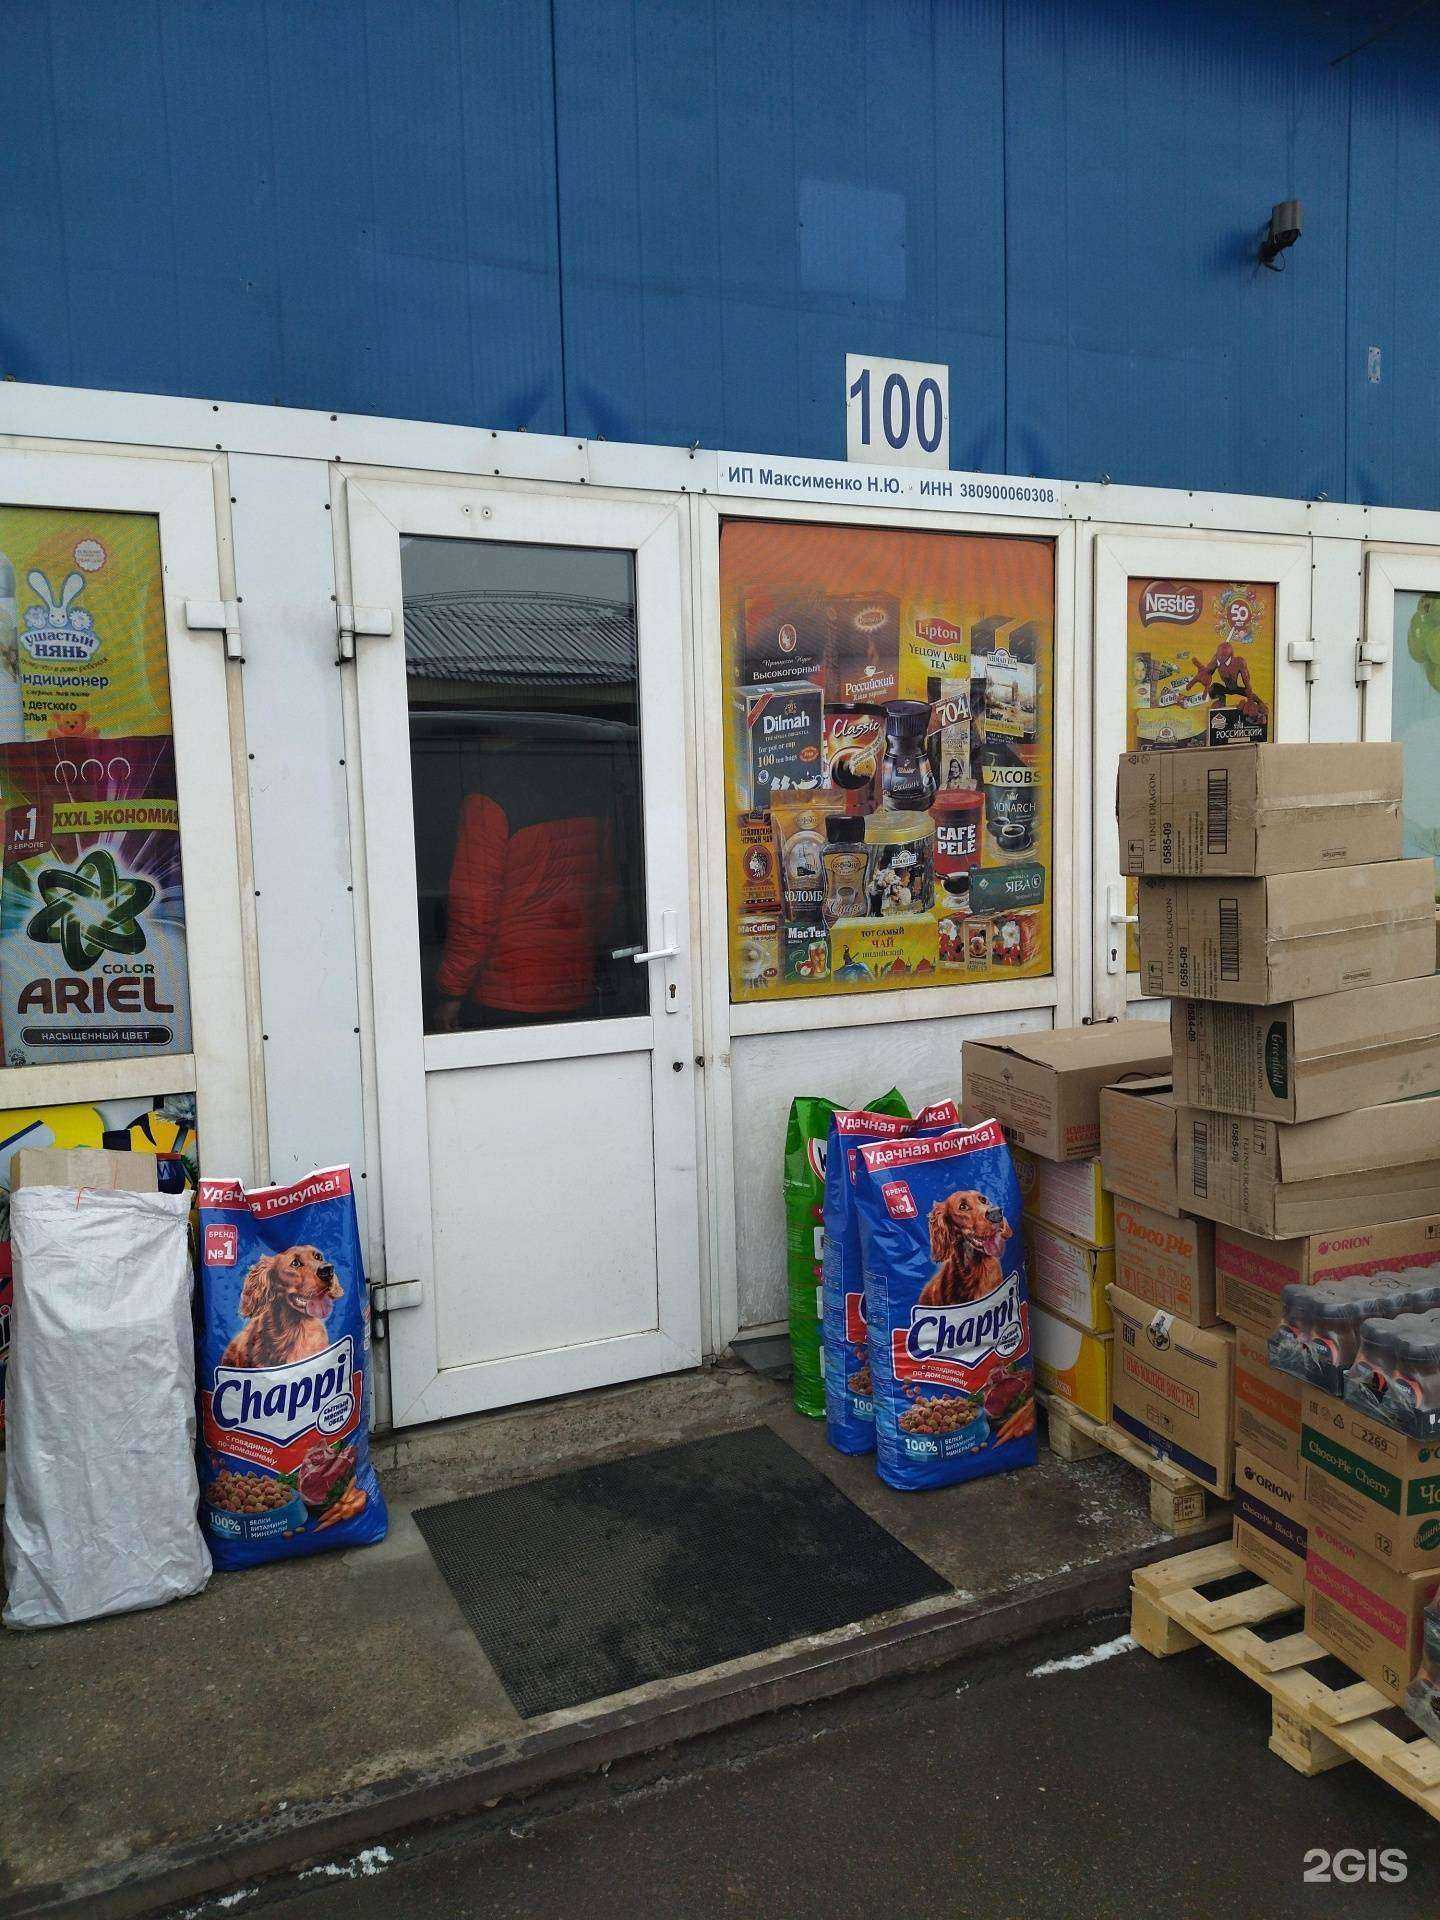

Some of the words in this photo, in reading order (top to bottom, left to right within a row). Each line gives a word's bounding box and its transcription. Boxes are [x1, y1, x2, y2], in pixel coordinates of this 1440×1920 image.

[850, 369, 942, 452] 100
[728, 466, 753, 484] ИП
[759, 469, 862, 492] Максименко
[867, 477, 903, 494] Н.Ю.
[919, 480, 952, 497] ИНН
[960, 484, 1054, 503] 380900060308
[1230, 604, 1249, 621] 50
[918, 622, 958, 640] Lipton
[930, 659, 946, 670] TEA
[936, 695, 970, 727] 704
[763, 710, 810, 734] Dilmah
[833, 718, 880, 739] Classic
[757, 754, 774, 768] 100
[990, 767, 1041, 784] JACOBS
[1149, 773, 1157, 816] DRAGON
[993, 802, 1036, 813] MONARCH
[53, 810, 91, 827] XXXL
[1149, 818, 1157, 852] FLYING
[1162, 822, 1172, 865] 0585-09
[1166, 898, 1174, 939] DRAGON
[788, 926, 827, 939] MacTea
[876, 926, 905, 937] САМЫЙ
[872, 936, 894, 948] ЧАЙ
[102, 964, 155, 975] COLOR
[1179, 946, 1188, 987] 0585-09
[18, 977, 174, 1014] ARIEL
[42, 1029, 118, 1041] НАСЫЩЕННЫЙ
[121, 1031, 150, 1041] ЦВЕТ
[838, 1115, 896, 1133] Удачная
[865, 1143, 931, 1165] Удачная
[934, 1126, 995, 1152] покупка!
[266, 1176, 340, 1210] покупка!
[208, 1240, 234, 1260] №1
[1332, 1236, 1370, 1252] ORION
[908, 1286, 1016, 1359] Chappi
[213, 1354, 348, 1429] Chappi
[905, 1438, 937, 1452] 100%
[1360, 1429, 1388, 1452] 2269
[1256, 1475, 1292, 1503] ORION
[1355, 1468, 1390, 1498] Cherry
[210, 1511, 241, 1531] 100%
[1377, 1536, 1390, 1553] 12
[1385, 1669, 1398, 1688] 12
